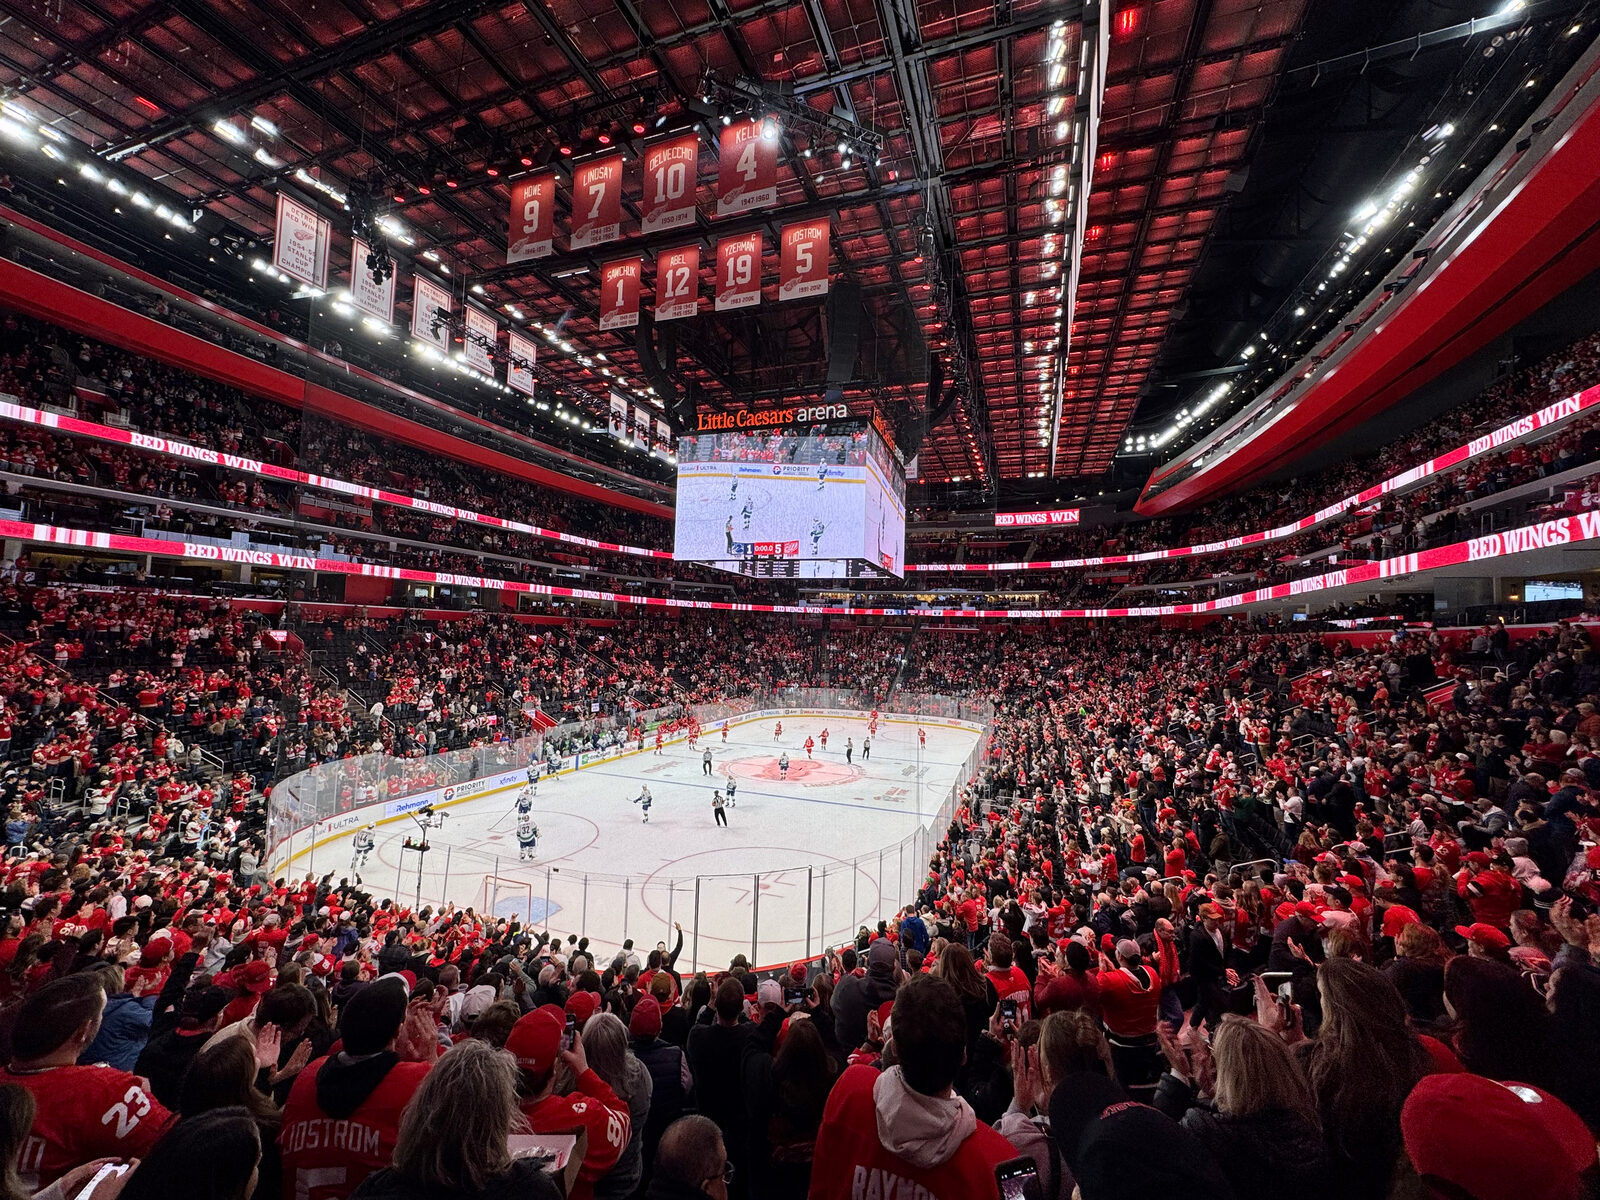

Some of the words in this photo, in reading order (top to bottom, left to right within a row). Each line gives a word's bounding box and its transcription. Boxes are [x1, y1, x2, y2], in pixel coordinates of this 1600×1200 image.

[735, 124, 764, 145] KELLY
[649, 146, 693, 172] DELVECCHIO
[736, 143, 757, 181] 4
[583, 166, 614, 187] LINDSAY
[654, 162, 686, 204] 10
[524, 184, 542, 200] HOWE
[587, 182, 606, 219] 7
[285, 212, 299, 224] RED
[301, 222, 323, 237] WINS
[290, 207, 319, 226] DETROI
[523, 200, 540, 234] 9
[788, 228, 822, 246] LIDSTROM
[287, 245, 317, 264] STANLE
[725, 241, 755, 257] YZERMAN
[796, 242, 814, 274] 5
[295, 256, 309, 268] CUP
[670, 254, 687, 267] ABEL
[607, 265, 636, 282] SAWCHUK
[725, 254, 752, 287] 19
[664, 267, 690, 298] 12
[366, 295, 379, 304] CUP
[615, 279, 625, 307] 1
[697, 411, 735, 431] Little
[736, 409, 794, 429] Caesars
[797, 404, 848, 422] arena
[1468, 435, 1491, 458] RED
[1491, 415, 1534, 447] WINGS
[1536, 392, 1582, 427] WIN
[130, 432, 165, 451] RED
[166, 440, 219, 463] WINGS
[223, 453, 263, 473] WIN
[412, 498, 429, 510] RED
[430, 502, 456, 516] WINGS
[456, 509, 478, 521] WIN
[995, 514, 1014, 525] RED
[1015, 513, 1047, 524] WINGS
[1049, 510, 1080, 523] WIN
[586, 538, 600, 547] WIN
[746, 543, 752, 554] 1
[754, 545, 773, 553] 0:00.0
[775, 544, 782, 554] 5
[1467, 534, 1501, 561] RED
[1502, 517, 1571, 555] WINGS
[184, 543, 219, 558] RED
[220, 546, 272, 565] WINGS
[276, 553, 316, 570] WIN
[1084, 557, 1103, 565] WIN
[436, 572, 453, 584] RED
[454, 574, 482, 587] WINGS
[482, 577, 505, 590] WIN
[1324, 569, 1347, 588] WIN
[600, 592, 615, 600] WIN
[695, 601, 712, 609] WIN
[773, 605, 785, 613] RED
[456, 780, 486, 793] PRIORITY
[499, 774, 518, 786] xfinity
[395, 799, 429, 812] Rehmann
[333, 815, 360, 830] ULTRA
[522, 825, 530, 835] 32
[101, 1085, 151, 1139] 23
